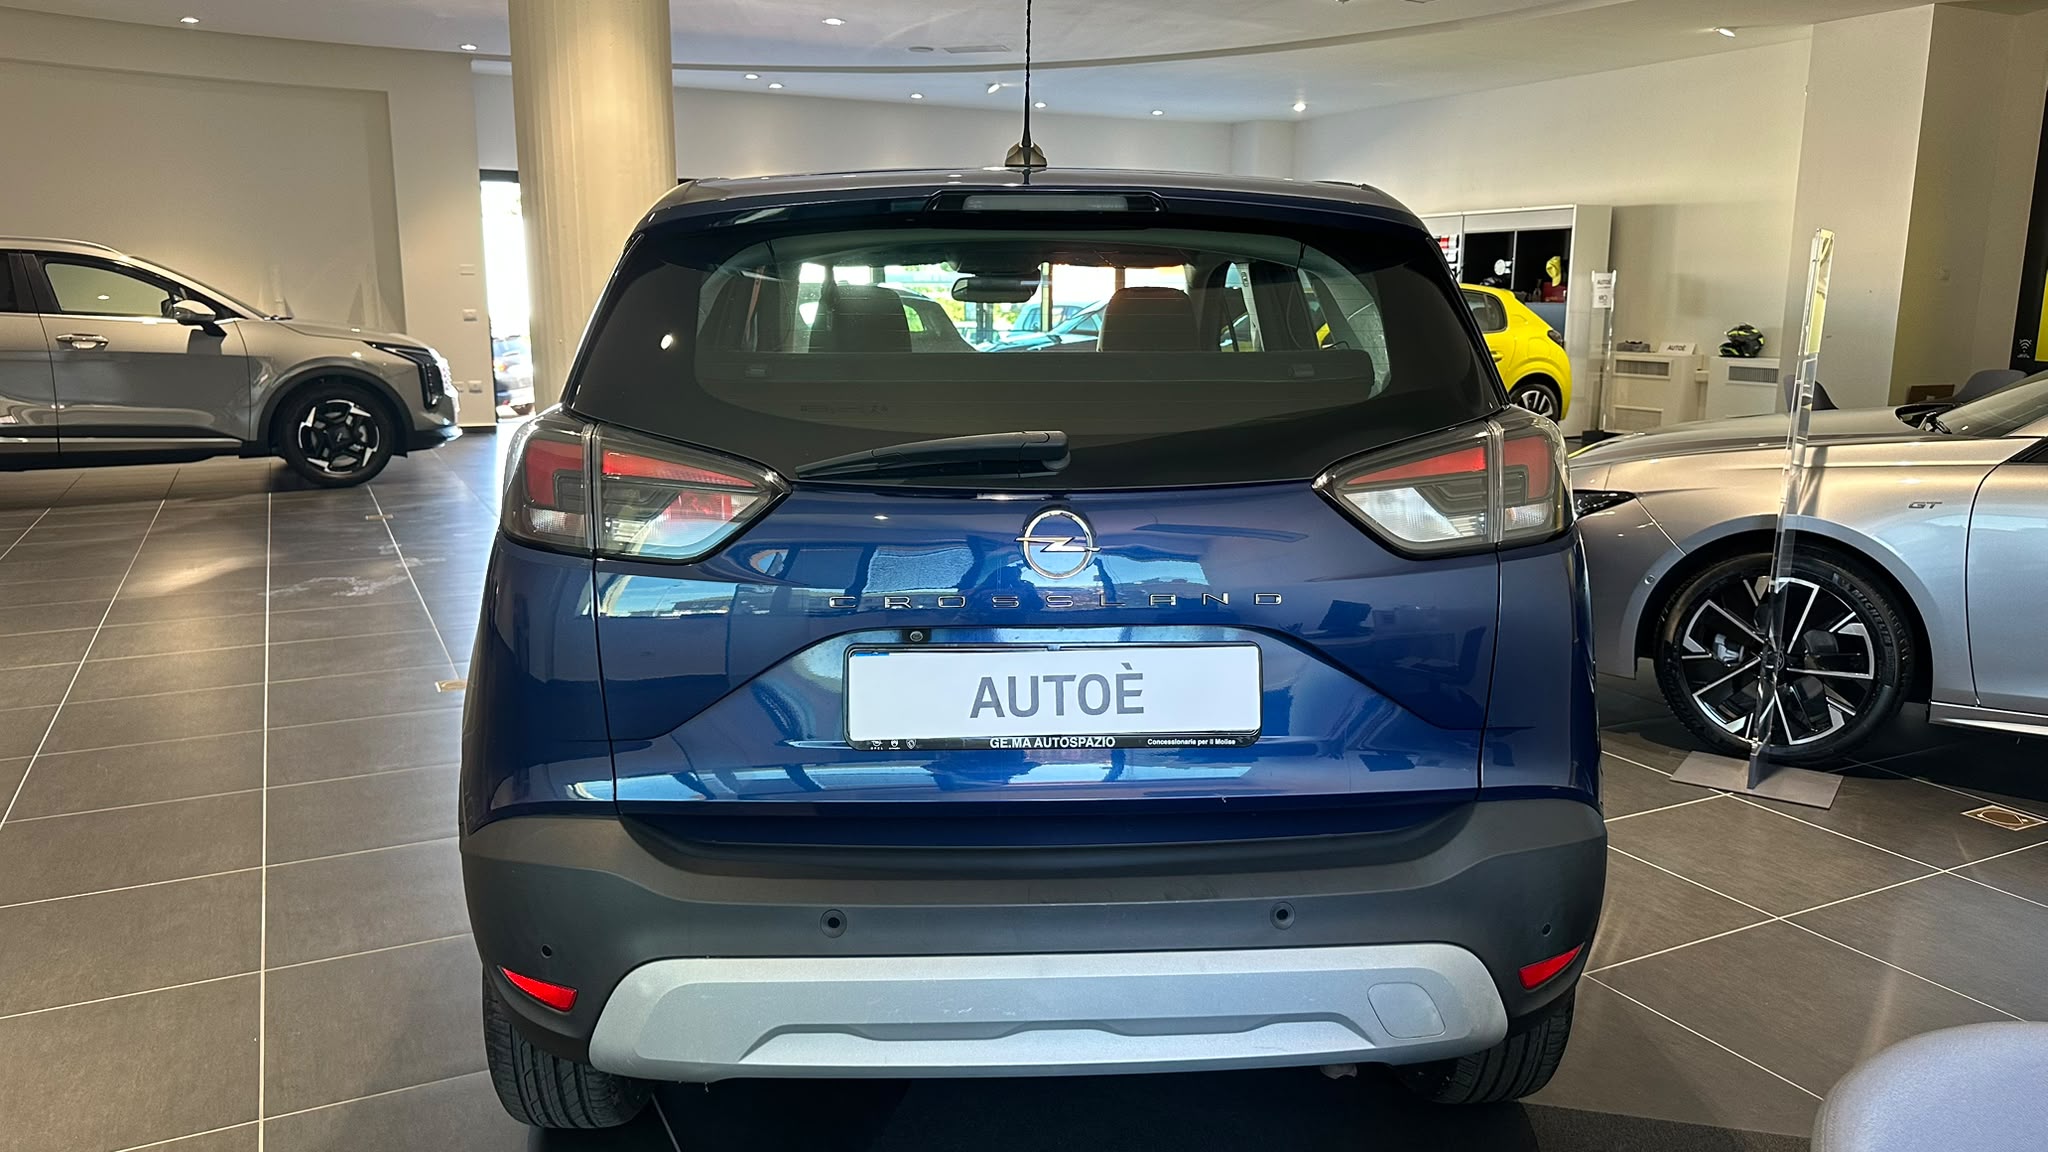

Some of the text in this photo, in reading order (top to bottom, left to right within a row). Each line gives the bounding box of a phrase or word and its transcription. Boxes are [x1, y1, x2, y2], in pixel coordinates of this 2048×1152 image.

[1908, 501, 1942, 509] GT
[829, 592, 1282, 608] CROSSLAND
[1851, 588, 1893, 647] MICHELIN
[969, 662, 1144, 720] AUTOÈ
[989, 736, 1116, 749] GE.MA AUTOSPAZIO
[1197, 738, 1208, 746] per
